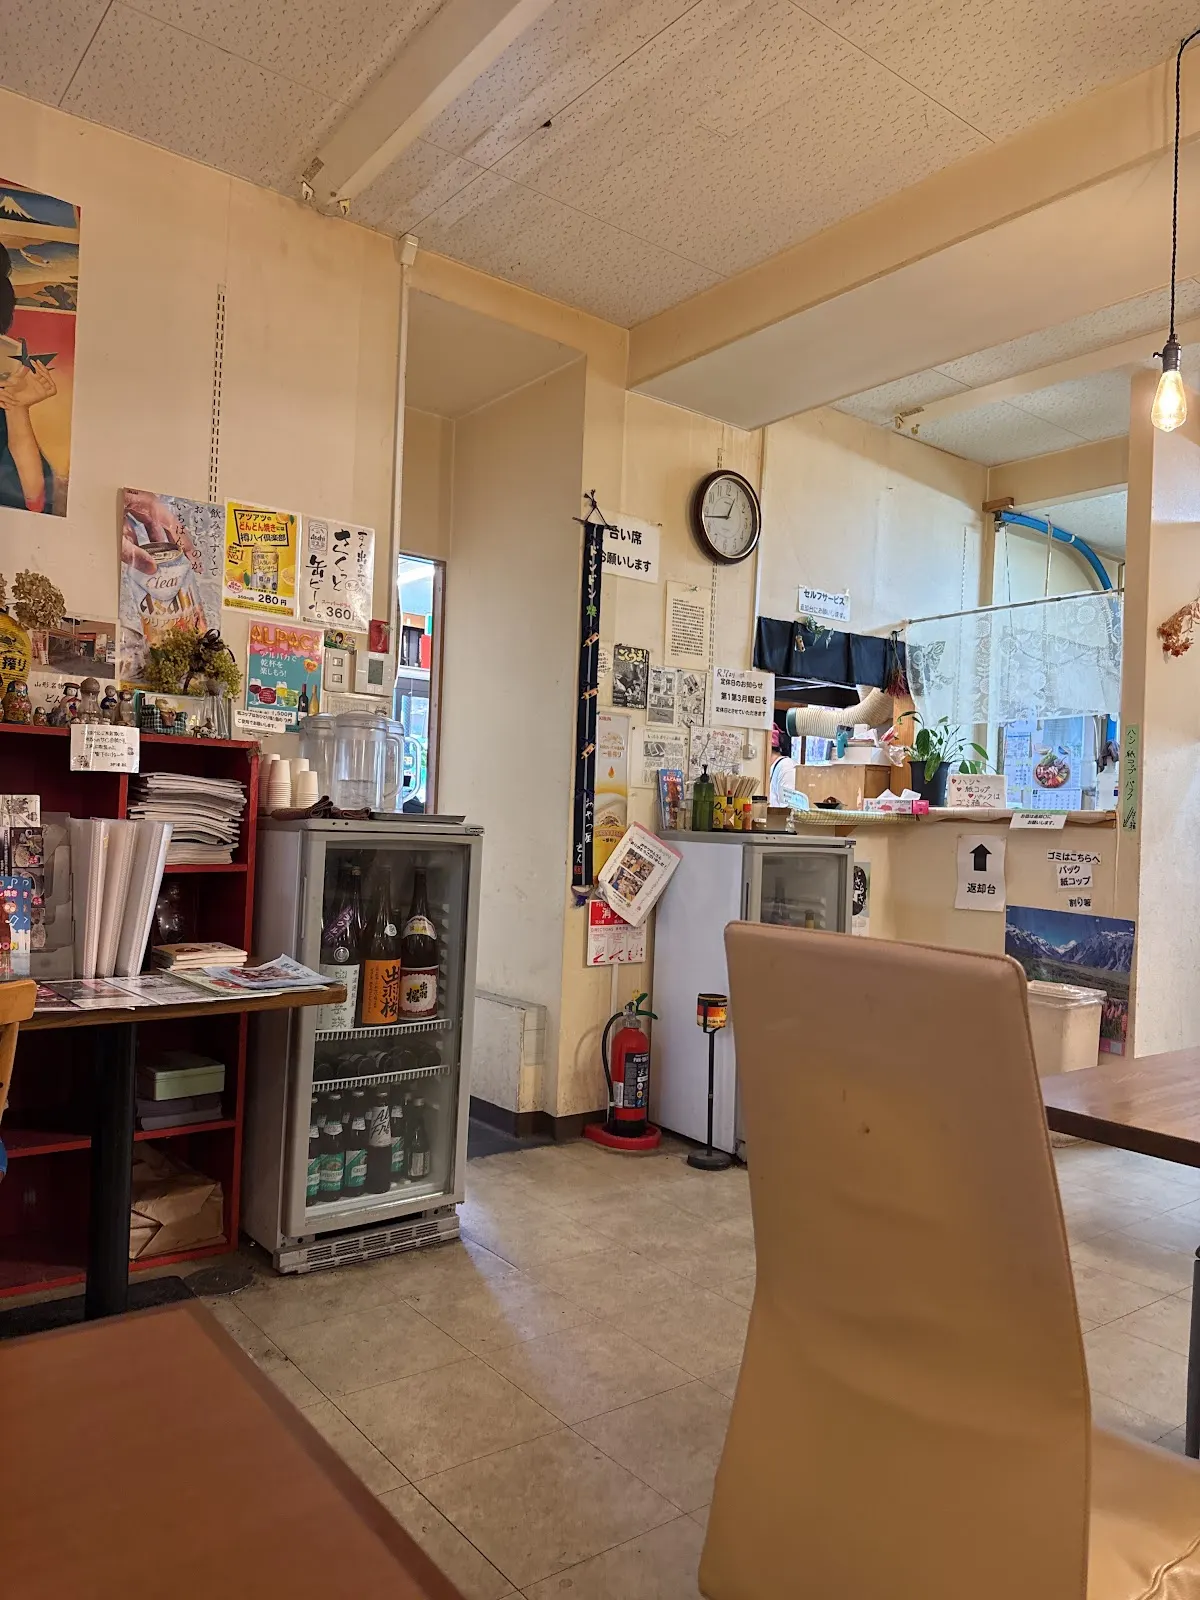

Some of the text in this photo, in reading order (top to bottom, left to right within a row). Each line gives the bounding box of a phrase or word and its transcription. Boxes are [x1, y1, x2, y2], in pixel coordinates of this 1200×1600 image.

[237, 512, 272, 521] アツアツの
[209, 508, 221, 577] 飲みやすくて
[146, 576, 181, 589] Clear
[803, 589, 845, 606] セルフサービス
[260, 658, 284, 669] 乾杯を
[720, 678, 763, 689] 定休日のお知らせ
[721, 692, 767, 705] 第1第3月曜日を
[716, 706, 766, 717] 定休日とさせていただきます
[1047, 851, 1101, 863] ゴミはこちらへ
[1059, 865, 1080, 875] パック
[1060, 876, 1091, 886] 紙コップ
[966, 882, 997, 895] 返却台
[1069, 896, 1092, 907] 割り箸
